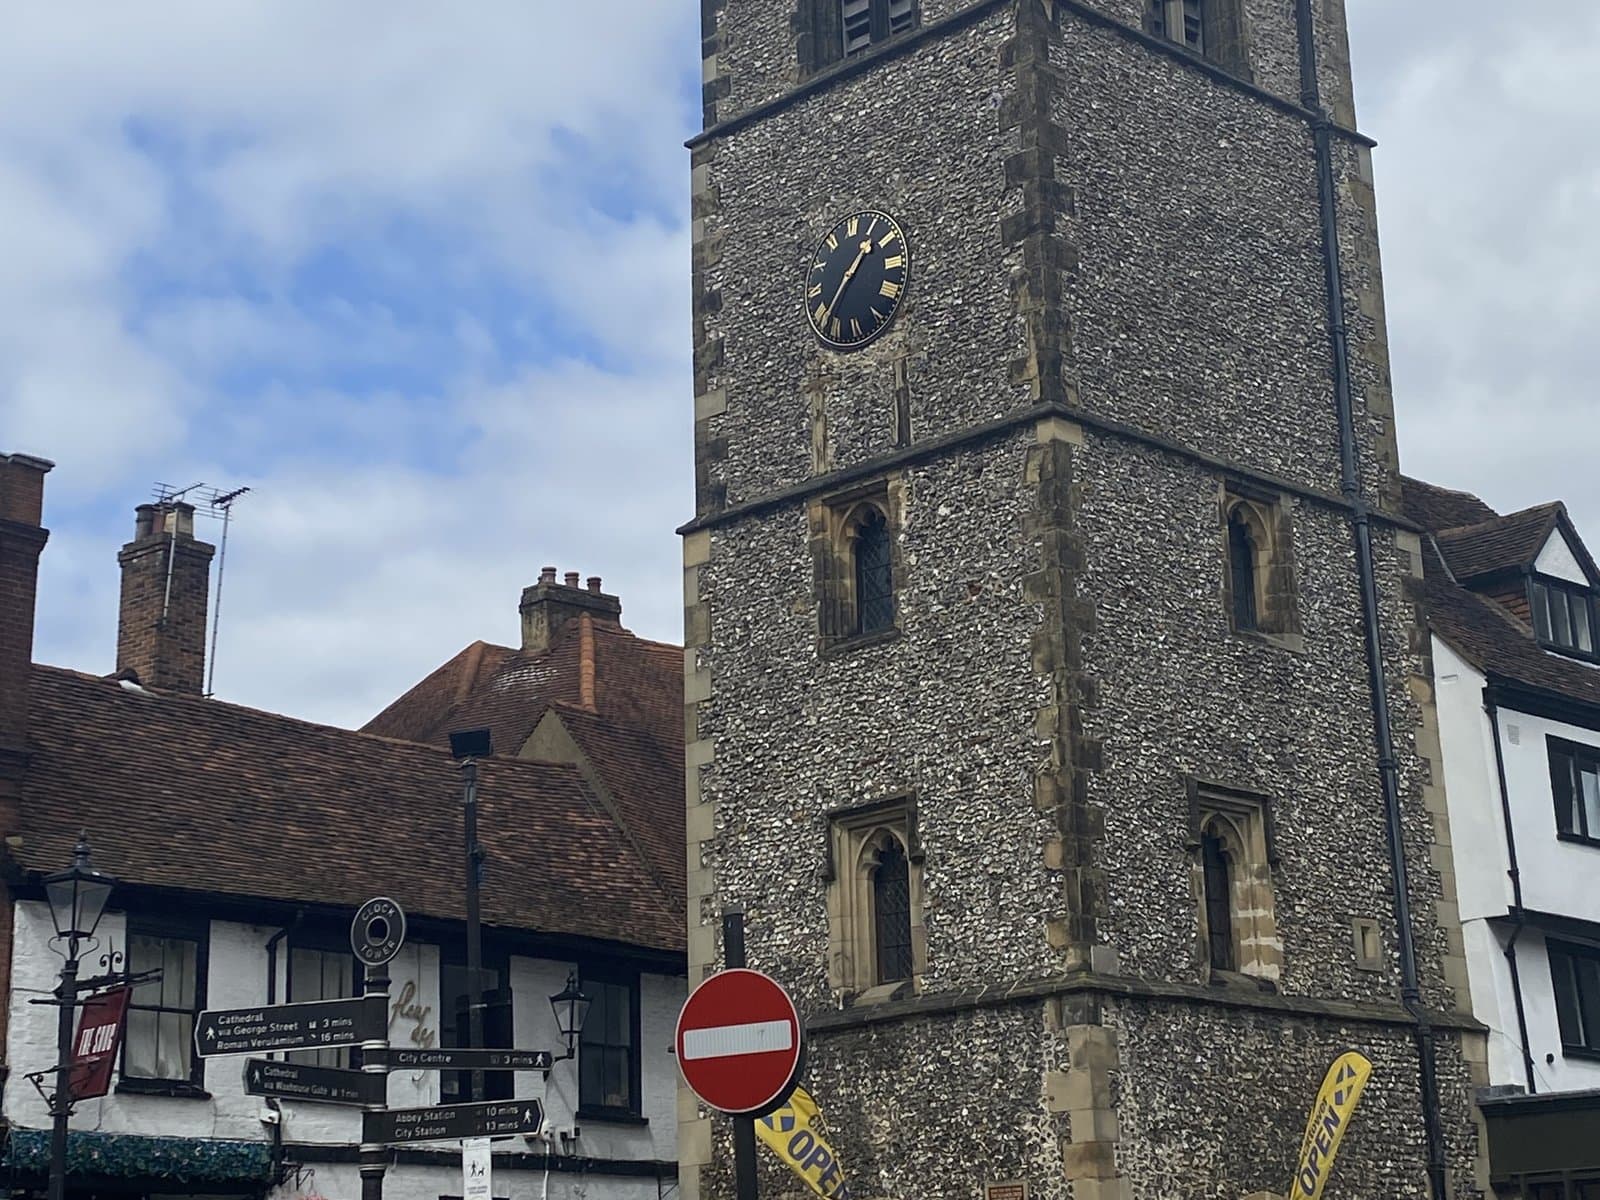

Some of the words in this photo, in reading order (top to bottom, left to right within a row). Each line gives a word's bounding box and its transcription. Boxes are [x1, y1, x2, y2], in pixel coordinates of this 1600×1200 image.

[361, 903, 396, 921] CLOCK
[360, 940, 396, 960] TOWER
[217, 1012, 264, 1025] Cathedral
[217, 1027, 231, 1037] via
[233, 1024, 267, 1036] George
[269, 1022, 299, 1033] Street
[322, 1018, 330, 1028] 3
[331, 1017, 353, 1027] mins
[216, 1039, 249, 1050] Roman
[250, 1036, 304, 1048] Verulamium
[320, 1032, 331, 1042] 16
[333, 1030, 355, 1041] mins
[398, 1053, 418, 1064] City
[420, 1053, 452, 1064] Centre
[503, 1055, 511, 1065] 3
[512, 1055, 534, 1066] mins
[263, 1066, 298, 1079] Cathedral
[395, 1113, 422, 1127] Abbey
[423, 1110, 456, 1122] Station
[485, 1106, 496, 1117] 10
[498, 1105, 519, 1116] mins
[394, 1128, 412, 1139] City
[415, 1125, 446, 1137] Station
[485, 1121, 496, 1131] 13
[498, 1120, 519, 1131] mins
[1300, 1105, 1341, 1197] OPEN
